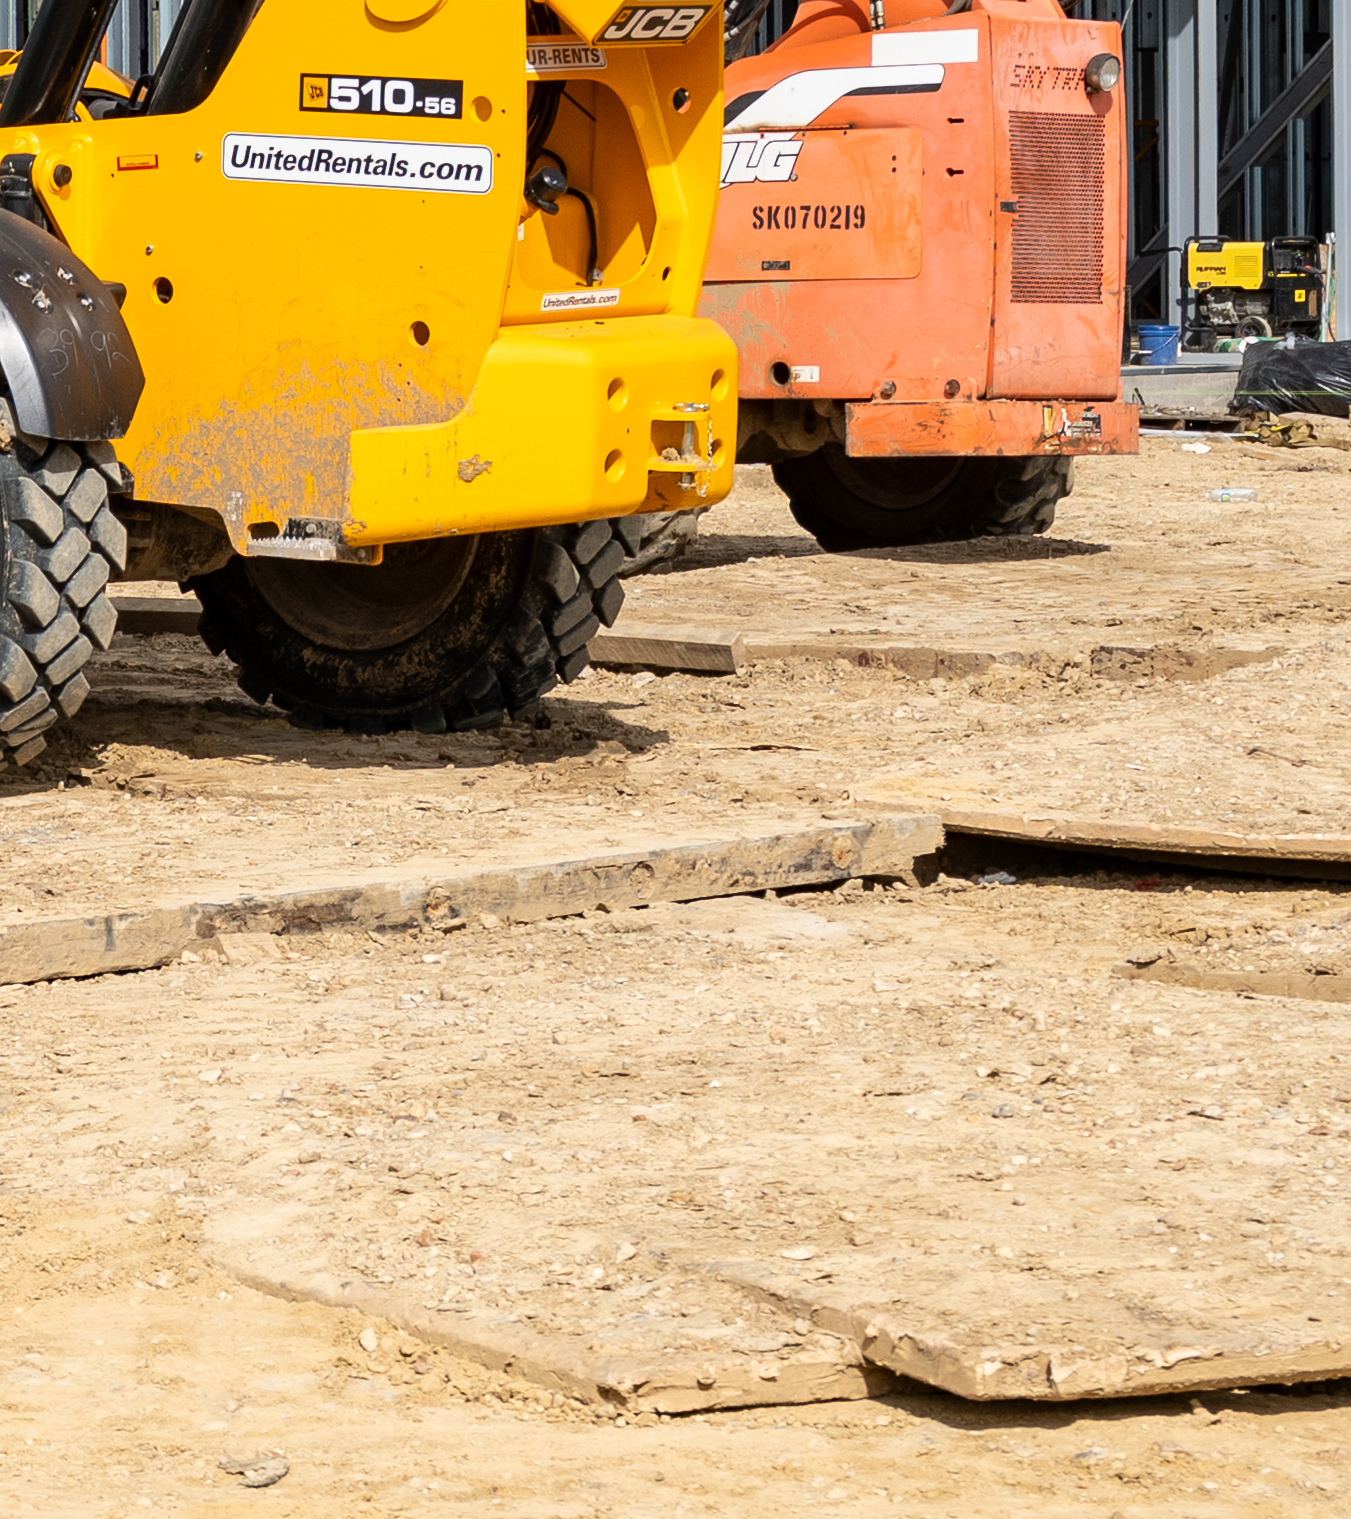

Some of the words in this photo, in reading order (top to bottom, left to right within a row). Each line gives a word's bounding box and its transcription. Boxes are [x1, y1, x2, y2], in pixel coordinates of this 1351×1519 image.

[604, 8, 706, 40] JCB
[230, 144, 484, 182] UnitedRentals.com
[751, 204, 866, 230] SK070219
[543, 294, 618, 308] UnitedRentals.com
